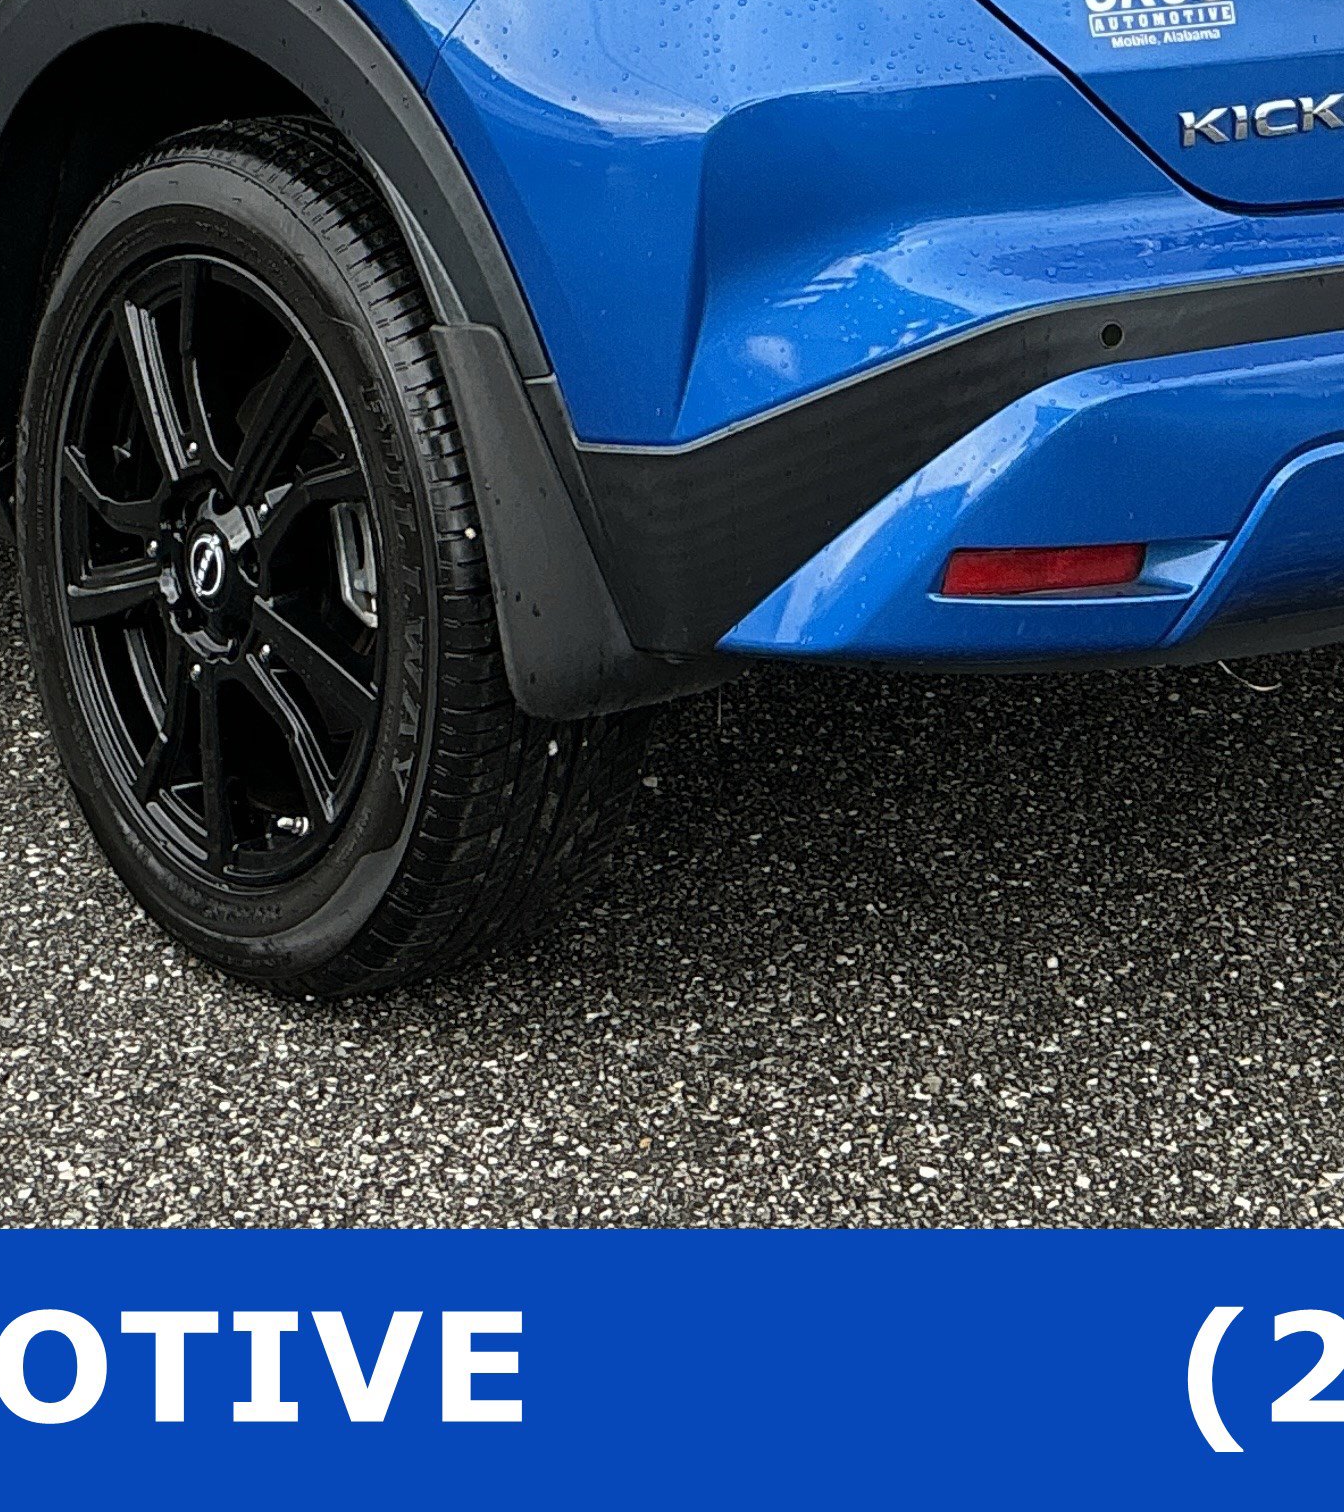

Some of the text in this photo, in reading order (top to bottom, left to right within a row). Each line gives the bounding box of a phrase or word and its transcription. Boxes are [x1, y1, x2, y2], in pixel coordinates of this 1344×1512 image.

[1094, 6, 1232, 32] AUTOMOTIVE
[1111, 28, 1221, 48] Mobile, Alabama
